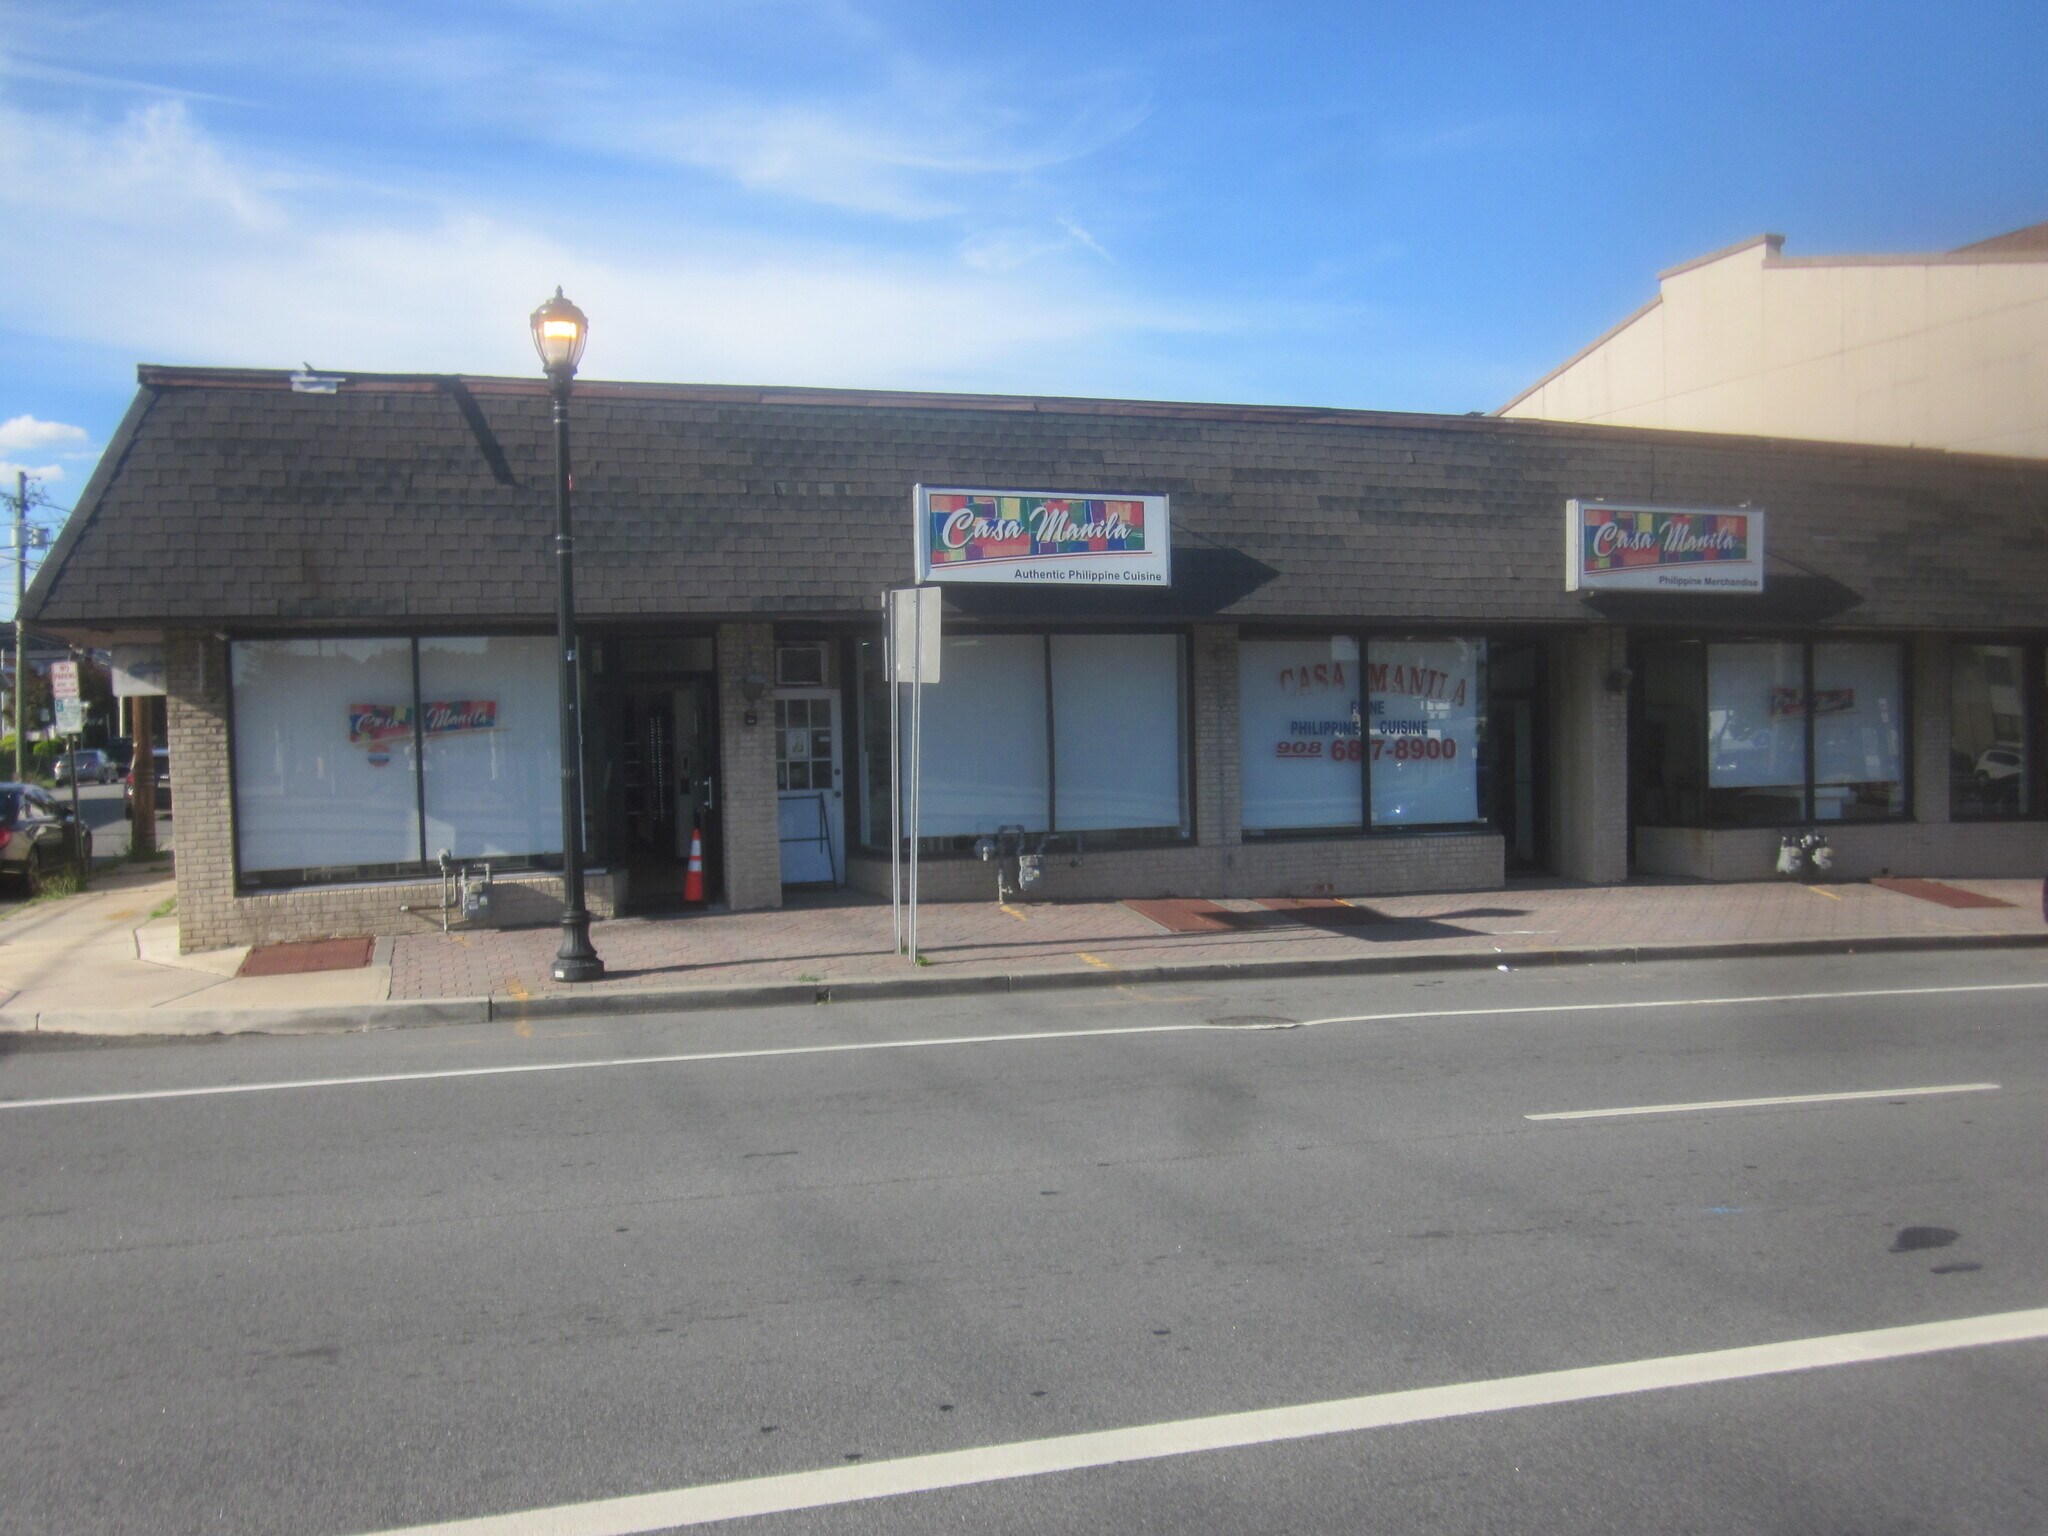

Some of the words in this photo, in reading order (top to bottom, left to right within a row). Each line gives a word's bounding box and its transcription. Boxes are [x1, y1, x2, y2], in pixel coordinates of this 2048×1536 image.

[942, 507, 1025, 550] Casa
[1029, 506, 1133, 543] Manila
[1593, 521, 1655, 557] Casa
[1658, 521, 1738, 552] Manila
[1014, 568, 1065, 580] Authentic
[1068, 569, 1120, 582] Philippine
[1123, 570, 1162, 581] Cuisine
[1658, 576, 1702, 587] Philippine
[1704, 576, 1759, 587] Merchandise
[1279, 662, 1346, 696] CASA
[1290, 720, 1360, 736] PHILIPPINE
[1379, 720, 1428, 736] CUISINE
[1276, 741, 1322, 754] 908
[1331, 737, 1457, 762] 687-8900
